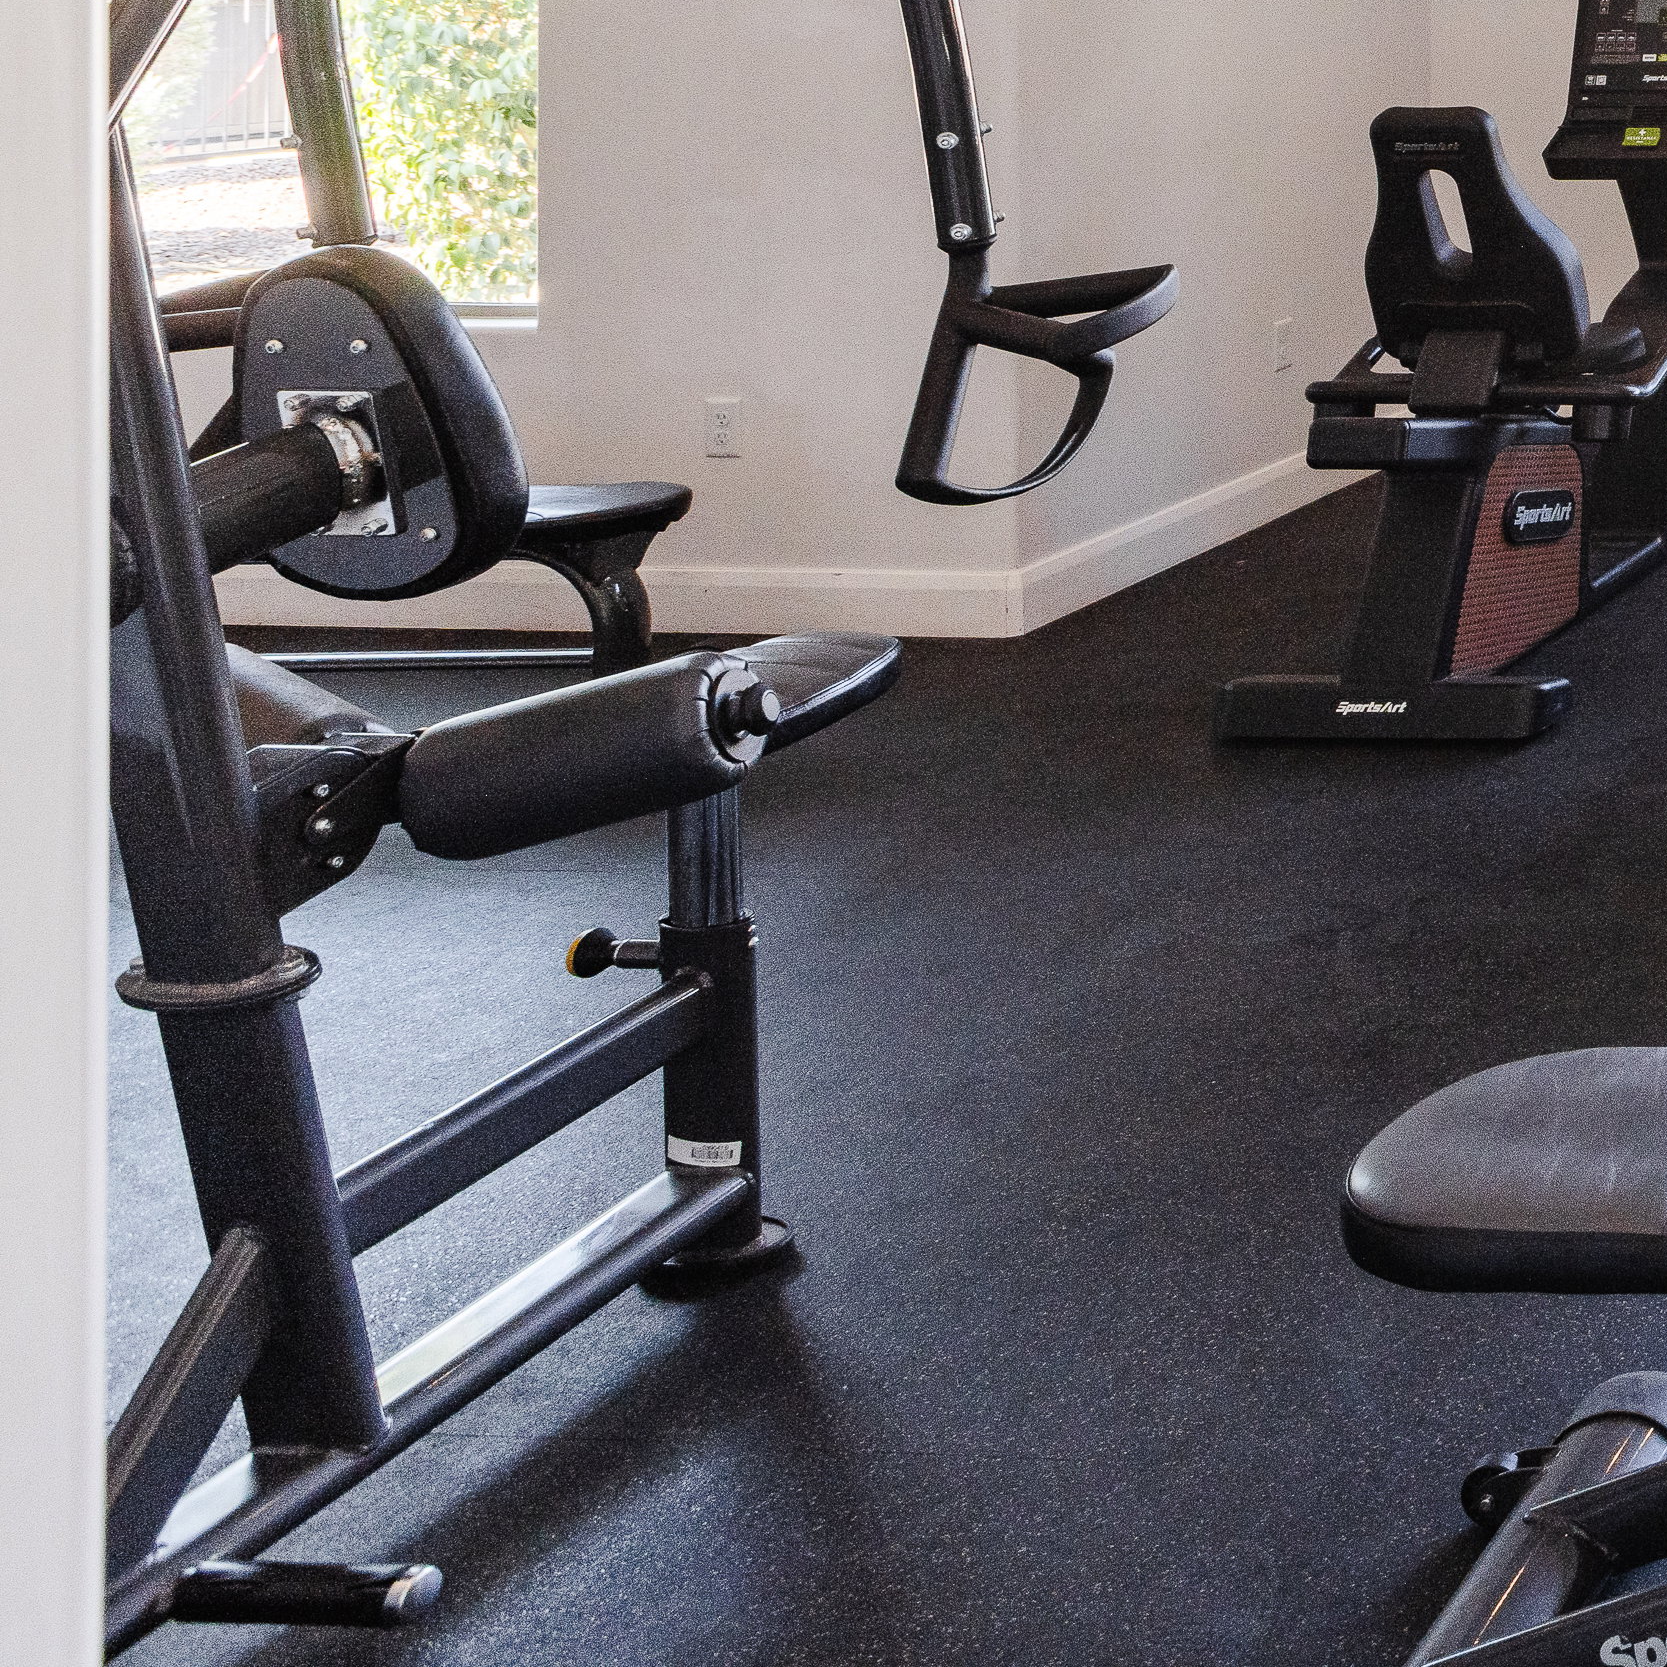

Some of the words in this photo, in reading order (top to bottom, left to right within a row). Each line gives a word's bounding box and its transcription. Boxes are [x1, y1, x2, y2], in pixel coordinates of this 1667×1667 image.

[1394, 141, 1460, 153] SportsArt
[1513, 502, 1573, 530] SportsArt
[1335, 701, 1408, 715] SportsArt
